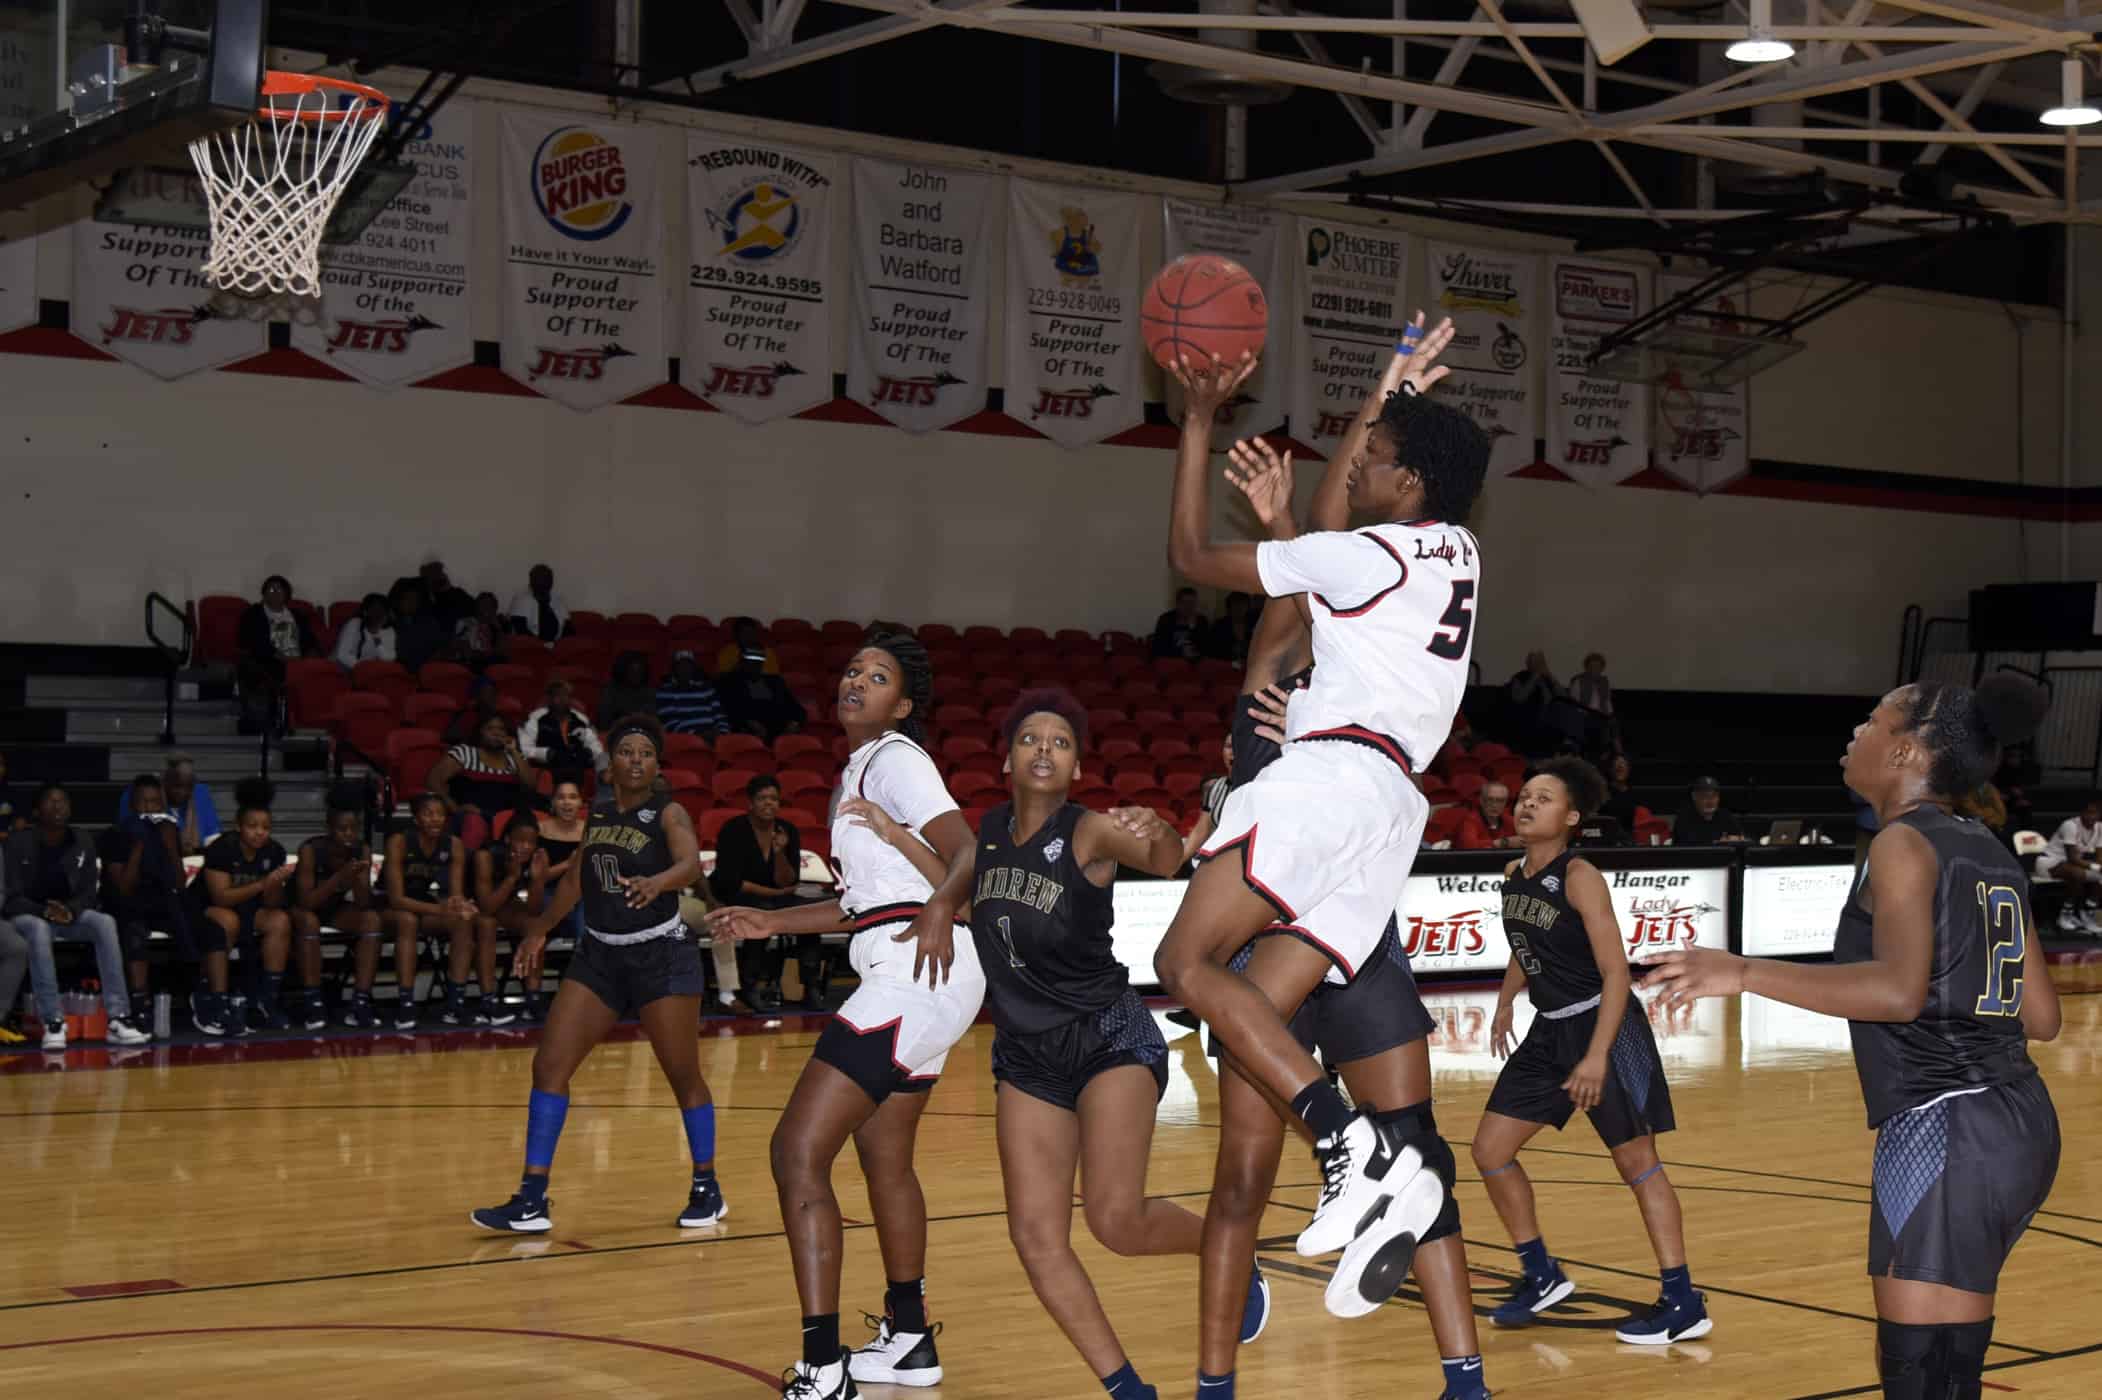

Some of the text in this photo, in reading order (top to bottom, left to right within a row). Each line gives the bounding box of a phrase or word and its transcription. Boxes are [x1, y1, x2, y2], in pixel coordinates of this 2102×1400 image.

[540, 145, 622, 188] BURGER
[545, 167, 627, 217] KING
[899, 167, 948, 192] John
[902, 200, 942, 223] and
[404, 217, 449, 235] Street
[101, 231, 211, 261] Support
[879, 222, 963, 256] Barbara
[1333, 231, 1400, 259] PHOEBE
[511, 245, 553, 260] Have
[571, 250, 609, 266] Your
[1330, 253, 1400, 279] SUMTER
[125, 264, 161, 288] Of
[689, 264, 822, 296] 229.924.9595
[879, 253, 961, 285] Watford
[367, 275, 465, 297] Supporter
[551, 271, 621, 293] Proud
[355, 294, 415, 312] Of the
[524, 287, 640, 313] Supporter
[728, 294, 788, 315] Proud
[892, 301, 951, 324] Proud
[1027, 287, 1121, 315] 229-928-0049
[103, 310, 194, 345] JETS
[545, 315, 621, 337] Of The
[704, 306, 806, 333] Supporter
[868, 315, 969, 342] Supporter
[1048, 319, 1104, 338] Proud
[327, 322, 408, 354] JETS
[723, 332, 787, 353] Of The
[1028, 331, 1121, 356] Supporter
[526, 349, 605, 382] JETS
[885, 342, 952, 364] Of The
[1327, 346, 1376, 364] Proud
[1043, 358, 1105, 377] Of The
[1311, 357, 1382, 381] Supporte
[702, 366, 777, 398] JETS
[871, 376, 937, 406] JETS
[1324, 383, 1347, 401] Of
[1577, 380, 1621, 395] Proud
[1030, 390, 1094, 420] JETS
[1559, 392, 1632, 410] Supporter
[1315, 412, 1356, 438] JET
[1573, 414, 1620, 431] Of The
[1562, 442, 1612, 465] JETS
[1413, 534, 1457, 567] Lady
[1426, 579, 1475, 661] 5
[1436, 871, 1691, 893] Welco Hangar
[1629, 895, 1681, 912] Lady
[997, 915, 1027, 968] 1
[1402, 913, 1698, 958] JETS JETS
[1509, 931, 1543, 975] 2
[1974, 880, 2026, 1017] 12
